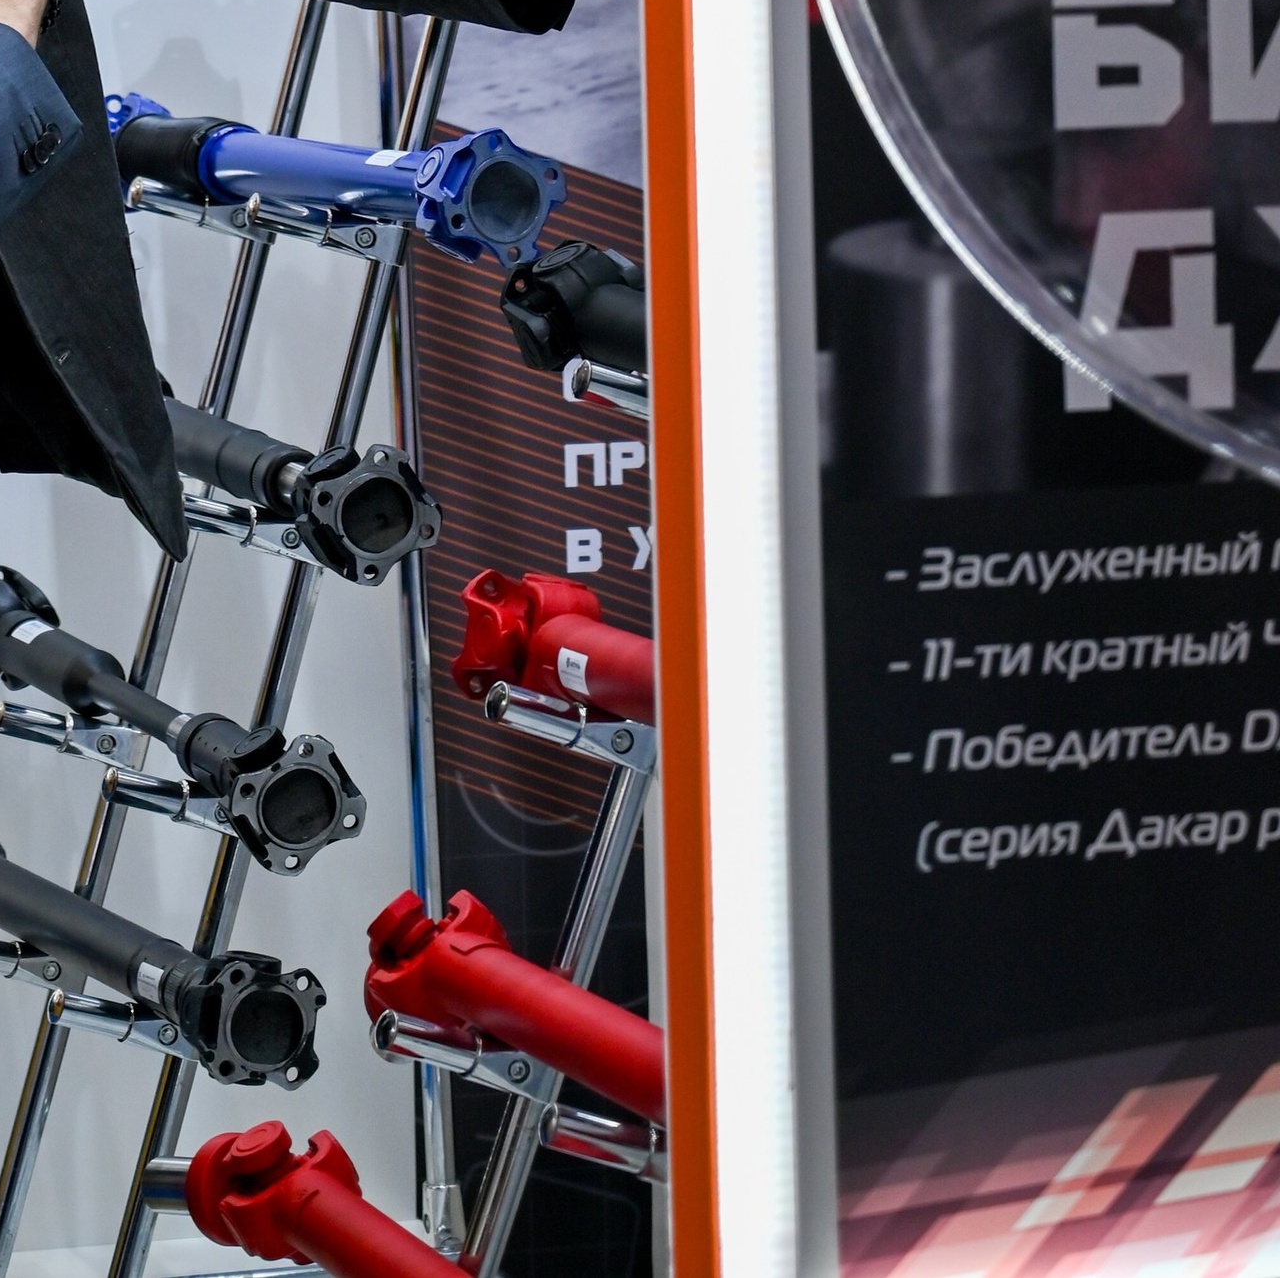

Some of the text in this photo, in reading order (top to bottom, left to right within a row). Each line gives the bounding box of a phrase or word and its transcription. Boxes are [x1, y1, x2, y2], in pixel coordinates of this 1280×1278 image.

[1064, 207, 1280, 412] Д
[566, 528, 603, 573] В
[917, 531, 1261, 594] Заслуженный
[922, 638, 1033, 682] 11-ти
[1041, 621, 1252, 683] кратный
[923, 722, 1231, 773] Победитель
[1241, 709, 1280, 753] D
[916, 821, 1081, 873] (серия
[1084, 809, 1249, 861] Дакар
